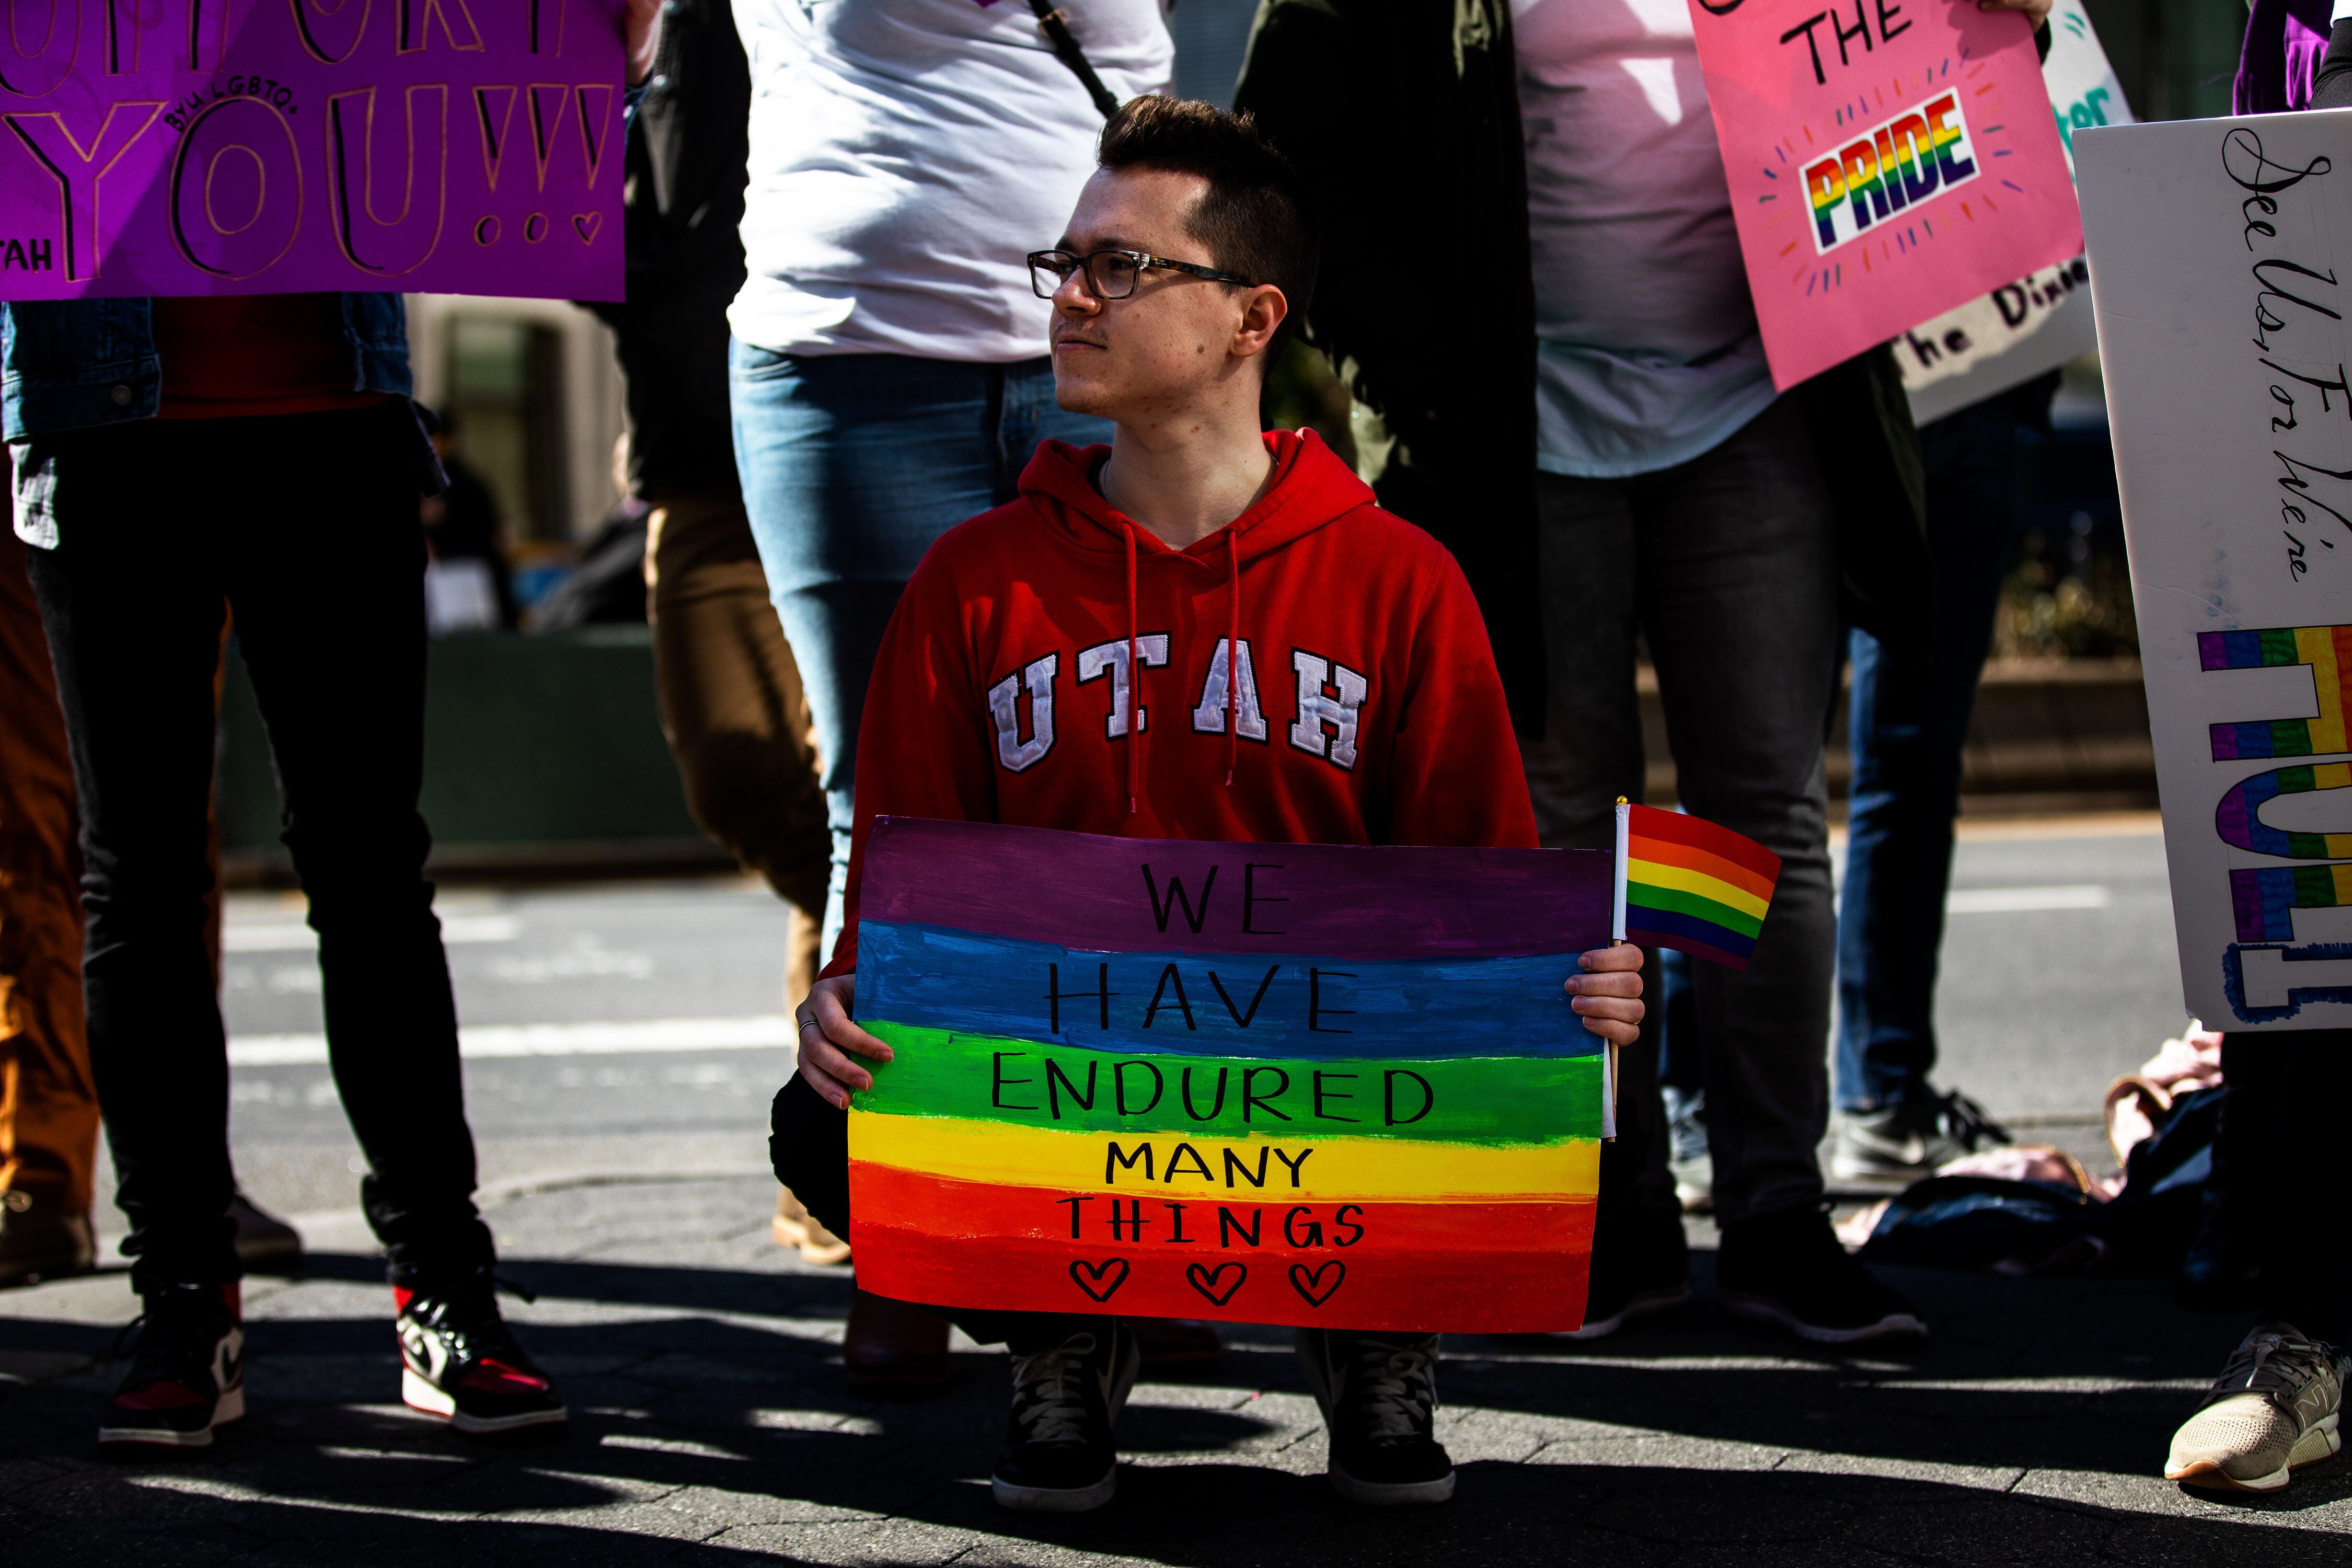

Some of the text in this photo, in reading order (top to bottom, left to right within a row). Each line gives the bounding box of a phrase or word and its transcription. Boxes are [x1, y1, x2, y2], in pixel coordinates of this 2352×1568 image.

[1780, 0, 1912, 85] THE
[164, 91, 205, 132] BYU
[1805, 94, 1976, 249] PRIDE
[2221, 128, 2332, 251] See
[0, 238, 51, 271] AH
[2252, 259, 2343, 352] Us,
[1891, 330, 1973, 381] he
[2258, 358, 2352, 433] For
[2273, 450, 2352, 583] We're
[987, 631, 1369, 773] UTAH
[1141, 863, 1290, 935] WE
[1044, 963, 1359, 1034] HAVE
[992, 1052, 1434, 1127] ENDURED
[1105, 1142, 1313, 1189] MANY
[1055, 1196, 1365, 1249] THINGS
